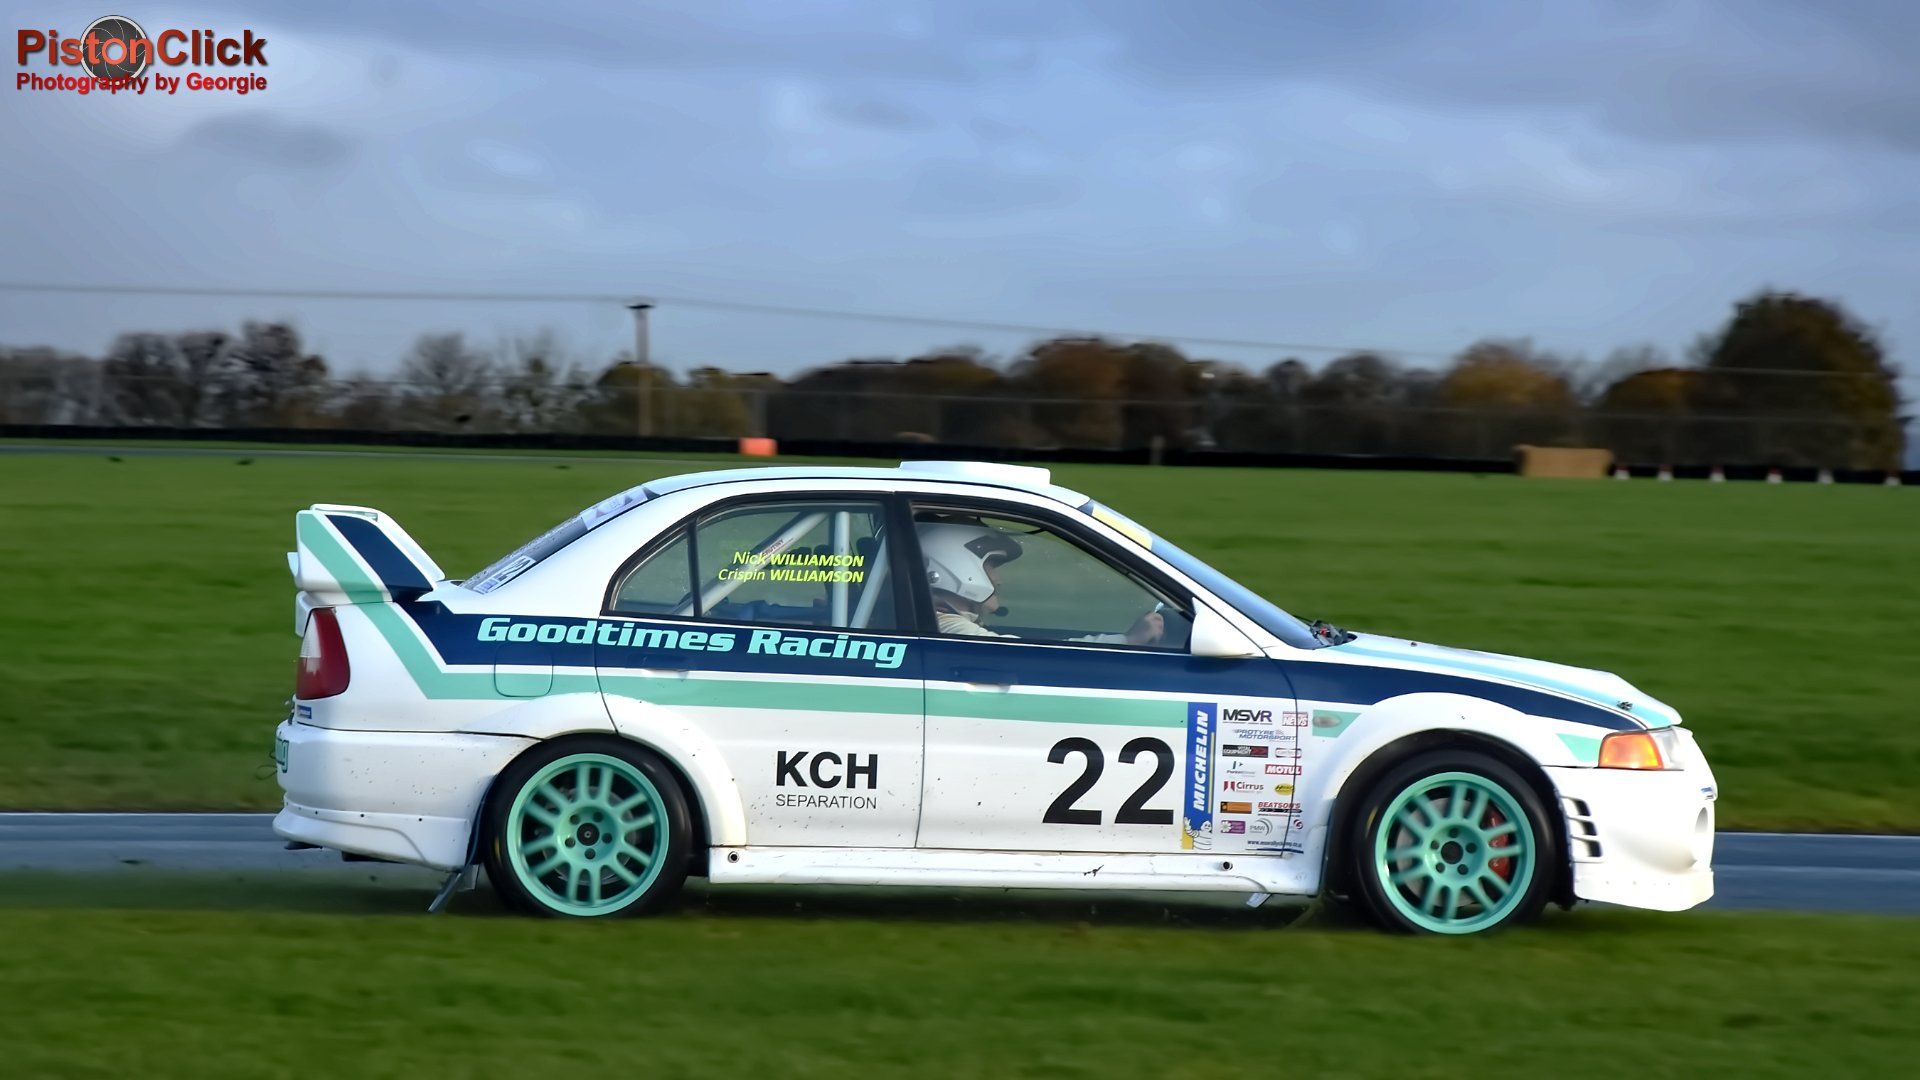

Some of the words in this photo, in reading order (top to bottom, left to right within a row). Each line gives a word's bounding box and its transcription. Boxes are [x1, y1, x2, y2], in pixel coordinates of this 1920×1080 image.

[733, 551, 766, 565] Nick
[770, 554, 865, 567] WILLIAMSON
[718, 569, 766, 583] Crispin
[770, 569, 864, 583] WILLIAMSON
[477, 617, 737, 653] Goodtimes
[747, 630, 908, 668] Racing
[1223, 709, 1273, 722] MSVR
[1193, 710, 1209, 812] MICHELIN
[776, 751, 878, 789] KCH
[1266, 765, 1301, 774] MOTUL
[1042, 737, 1175, 825] 22
[1236, 782, 1264, 790] Cirrus
[776, 794, 877, 809] SEPARATION
